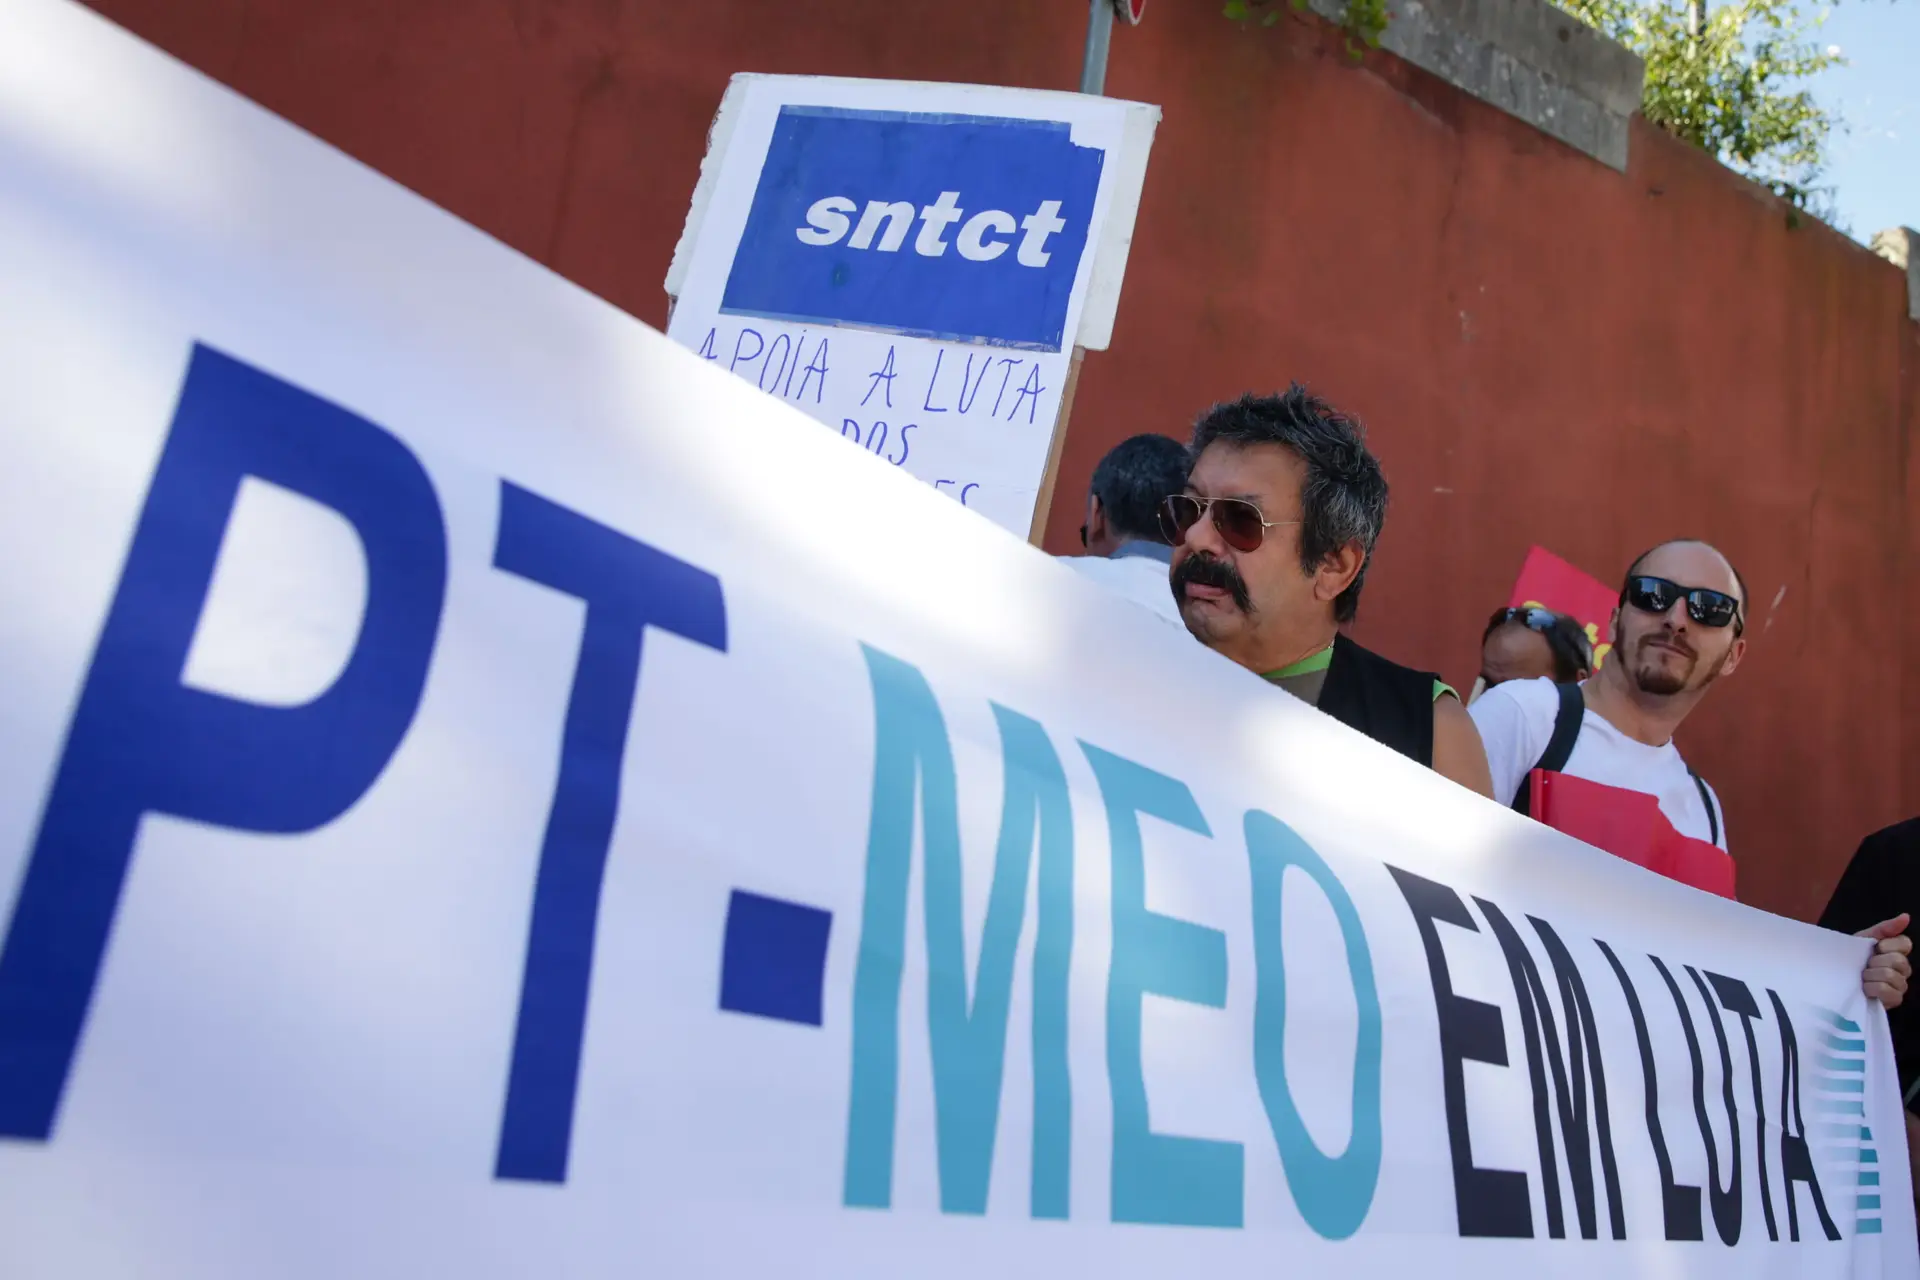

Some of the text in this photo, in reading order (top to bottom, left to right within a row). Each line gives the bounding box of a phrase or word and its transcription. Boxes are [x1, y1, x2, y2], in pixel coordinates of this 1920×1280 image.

[796, 191, 1067, 268] sntct
[860, 345, 898, 408] A
[923, 349, 1047, 424] LUTA
[1383, 861, 1627, 1240] EM
[1592, 937, 1843, 1248] LUTA
